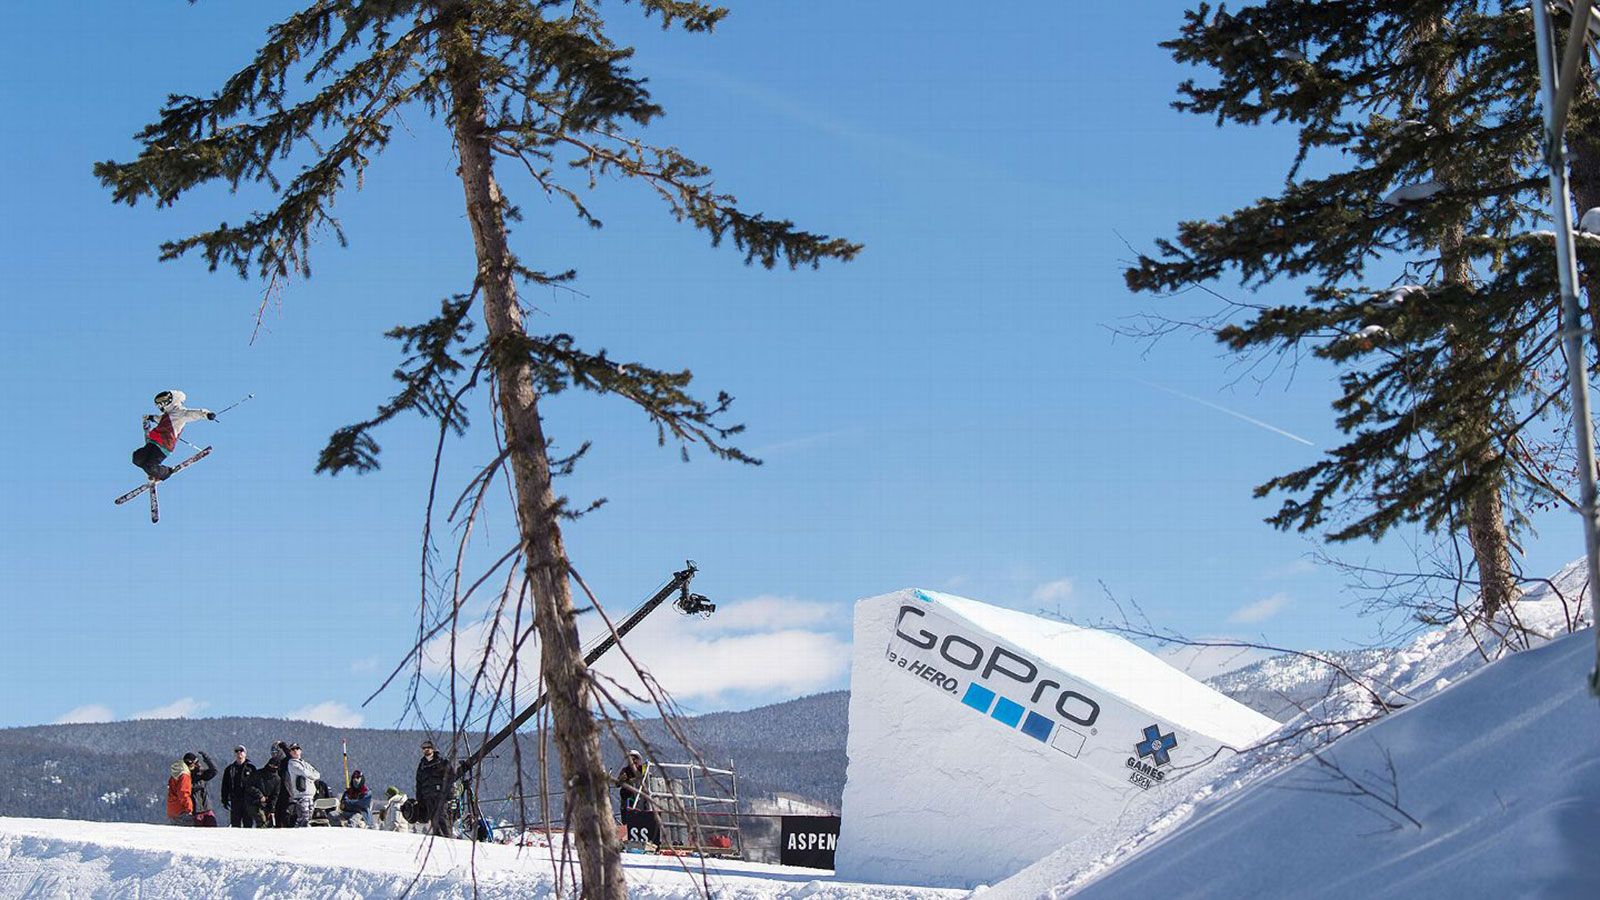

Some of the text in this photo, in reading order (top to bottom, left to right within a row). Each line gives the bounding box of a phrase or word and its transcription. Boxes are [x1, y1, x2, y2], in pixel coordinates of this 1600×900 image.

[898, 657, 908, 668] a
[907, 660, 958, 694] HERO.
[1127, 757, 1165, 781] GAMES
[1130, 772, 1151, 790] ASPEN
[788, 832, 836, 850] ASPEN
